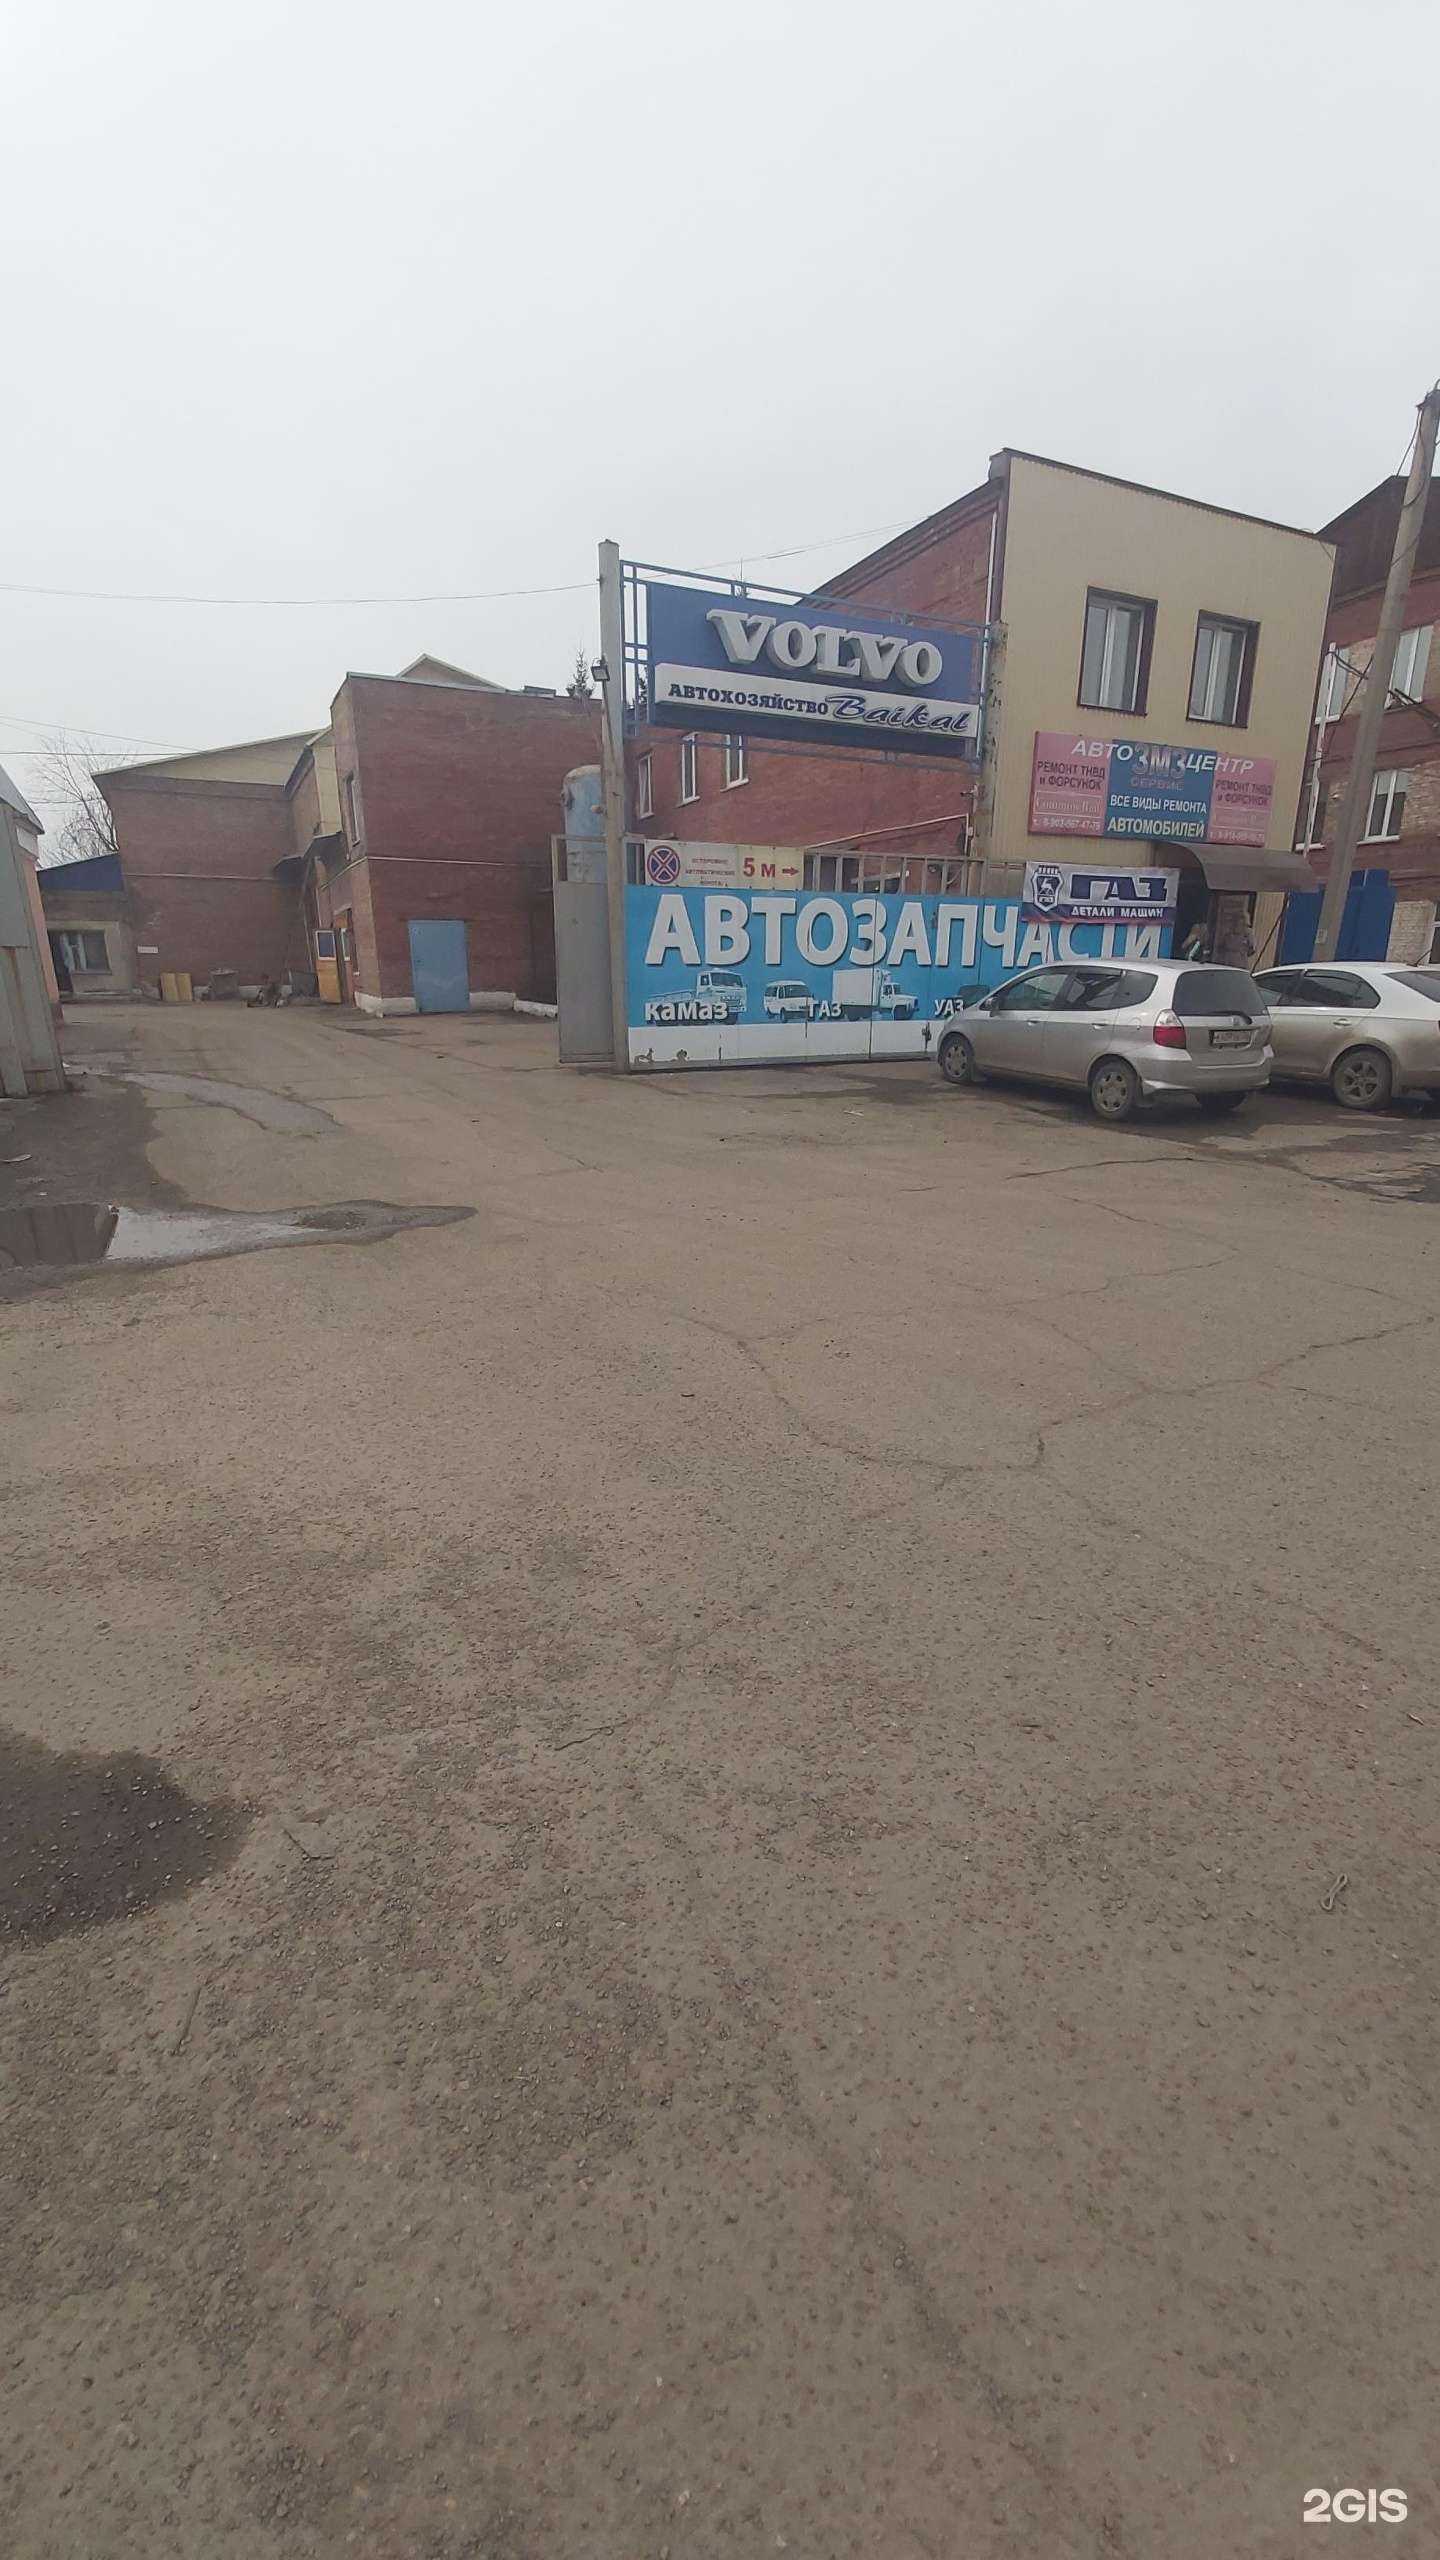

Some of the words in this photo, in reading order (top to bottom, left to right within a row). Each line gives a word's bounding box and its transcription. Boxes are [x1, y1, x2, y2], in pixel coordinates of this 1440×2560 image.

[706, 609, 943, 688] VOLVO
[668, 683, 829, 716] АВТОХОЗЯЙСТВО
[825, 694, 971, 731] Baikal
[1037, 761, 1077, 775] РЕМОНТ
[1186, 753, 1254, 774] ЦЕНТР
[1049, 776, 1103, 790] ФОРСУНОК
[1110, 795, 1130, 808] ВСЕ
[1132, 796, 1161, 811] ВИДЫ
[1163, 799, 1208, 814] РЕМОНТА
[1107, 817, 1206, 838] АВТОМОБИЛЕЙ
[743, 857, 755, 877] 5
[1070, 874, 1167, 902] ГАЗ
[1071, 906, 1115, 918] ДЕТАЛИ
[1120, 907, 1164, 918] МАШИН
[644, 894, 1162, 967] АВТОЗАПЧАСТИ
[807, 1000, 843, 1018] ГАЗ
[934, 999, 964, 1016] УАЗ
